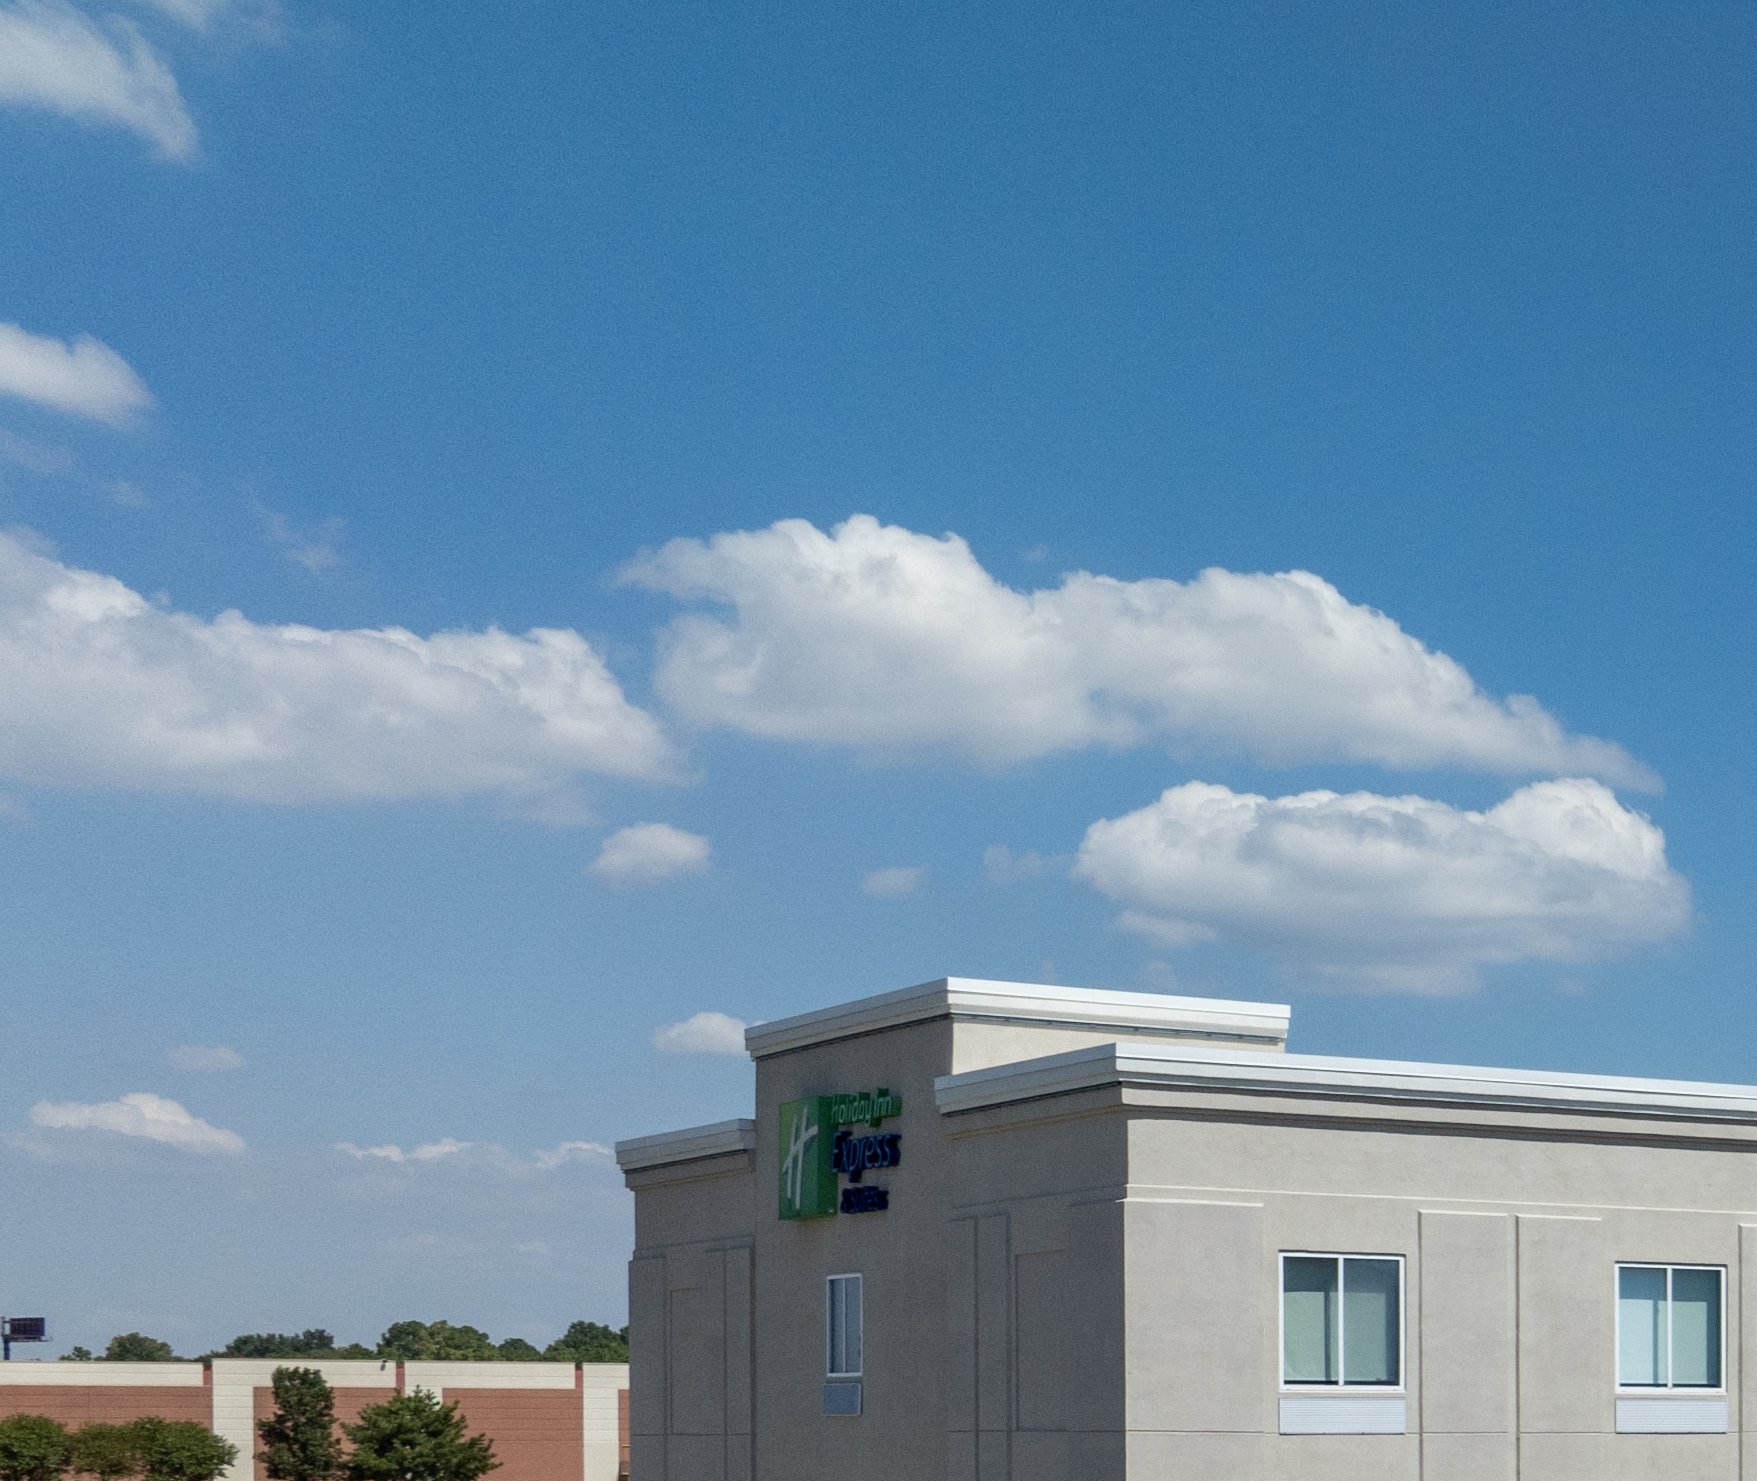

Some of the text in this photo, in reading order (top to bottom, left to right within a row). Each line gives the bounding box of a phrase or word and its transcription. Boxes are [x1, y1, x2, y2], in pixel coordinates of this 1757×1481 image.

[831, 1094, 892, 1126] Holiday Inn
[832, 1132, 890, 1176] Express
